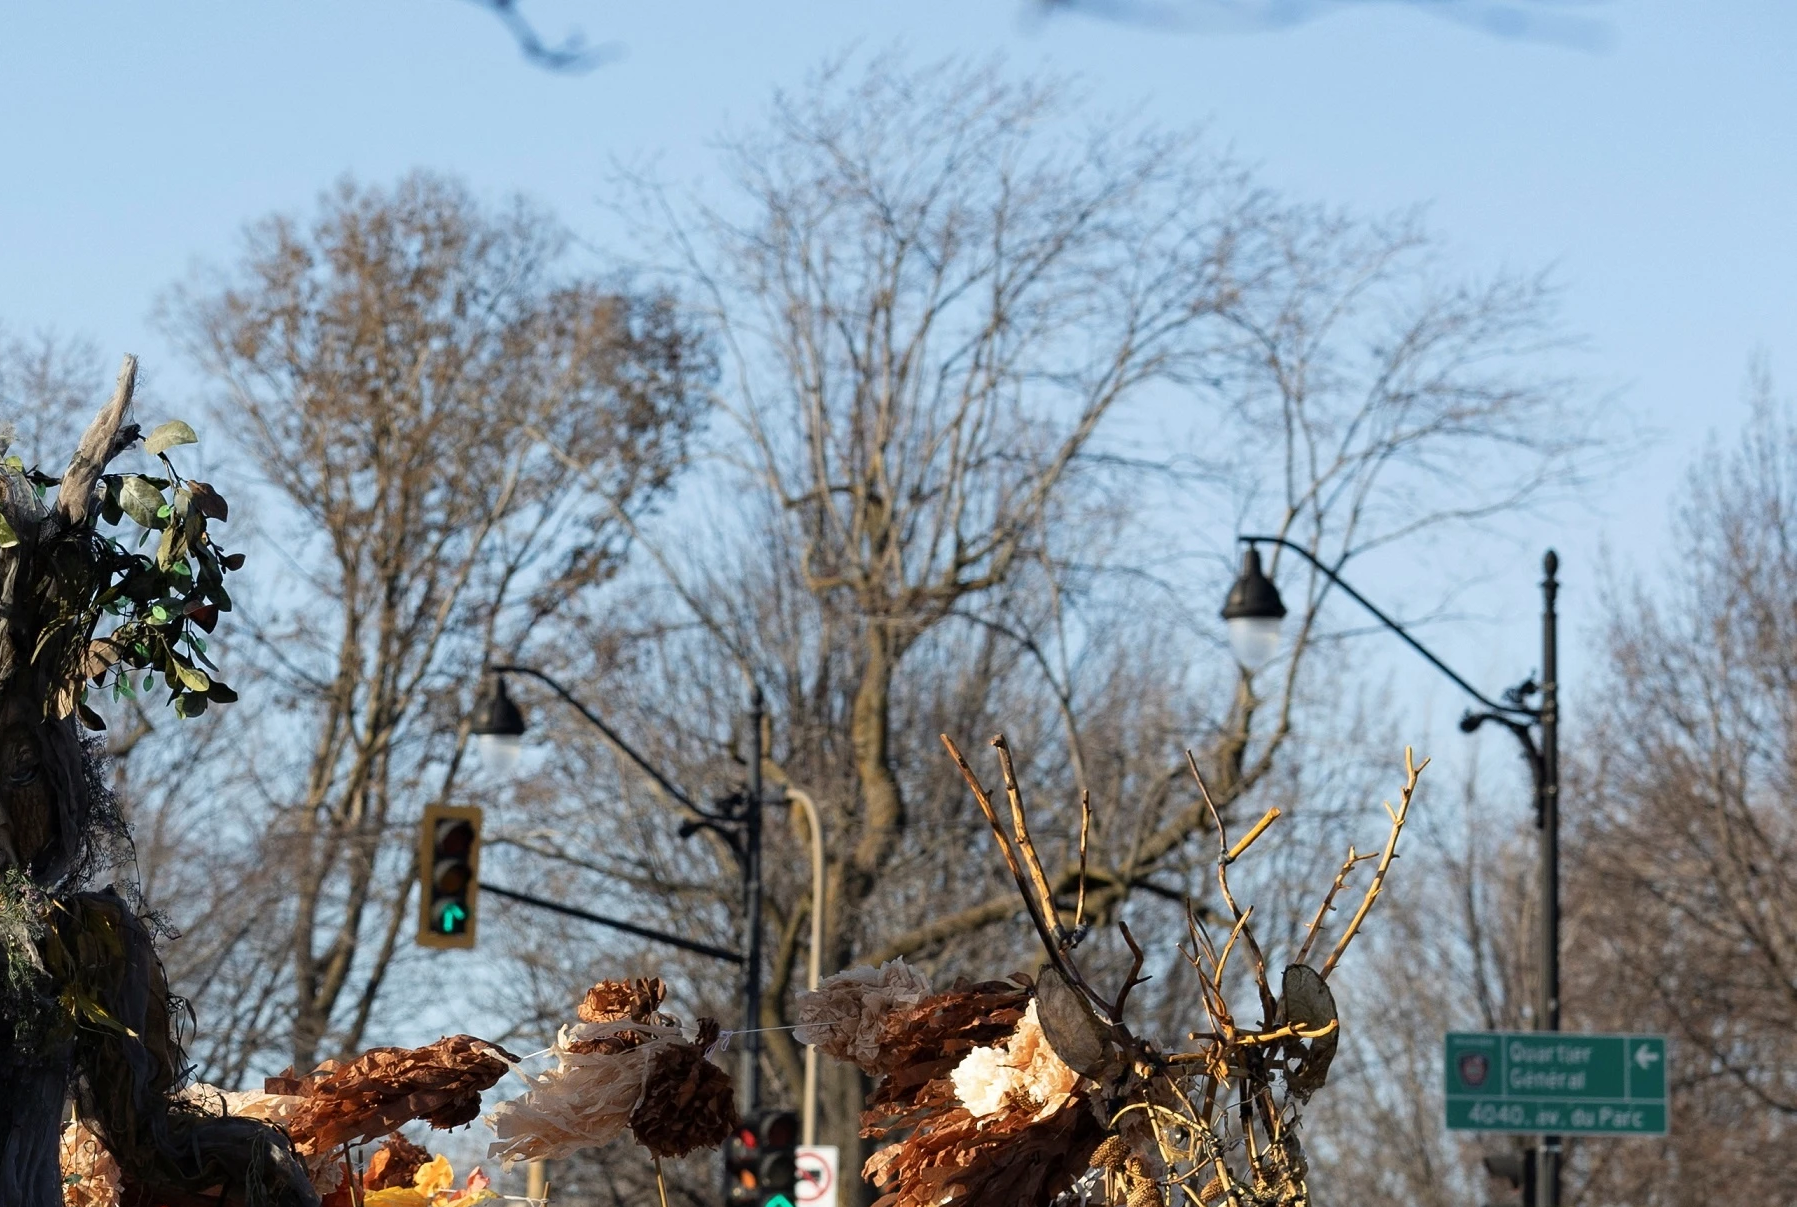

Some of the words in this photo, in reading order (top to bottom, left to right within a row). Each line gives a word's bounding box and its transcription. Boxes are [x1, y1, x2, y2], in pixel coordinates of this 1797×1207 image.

[1510, 1041, 1592, 1064] Quartier
[1510, 1067, 1586, 1090] Général
[1571, 1108, 1596, 1127] du
[1599, 1107, 1643, 1128] Parc
